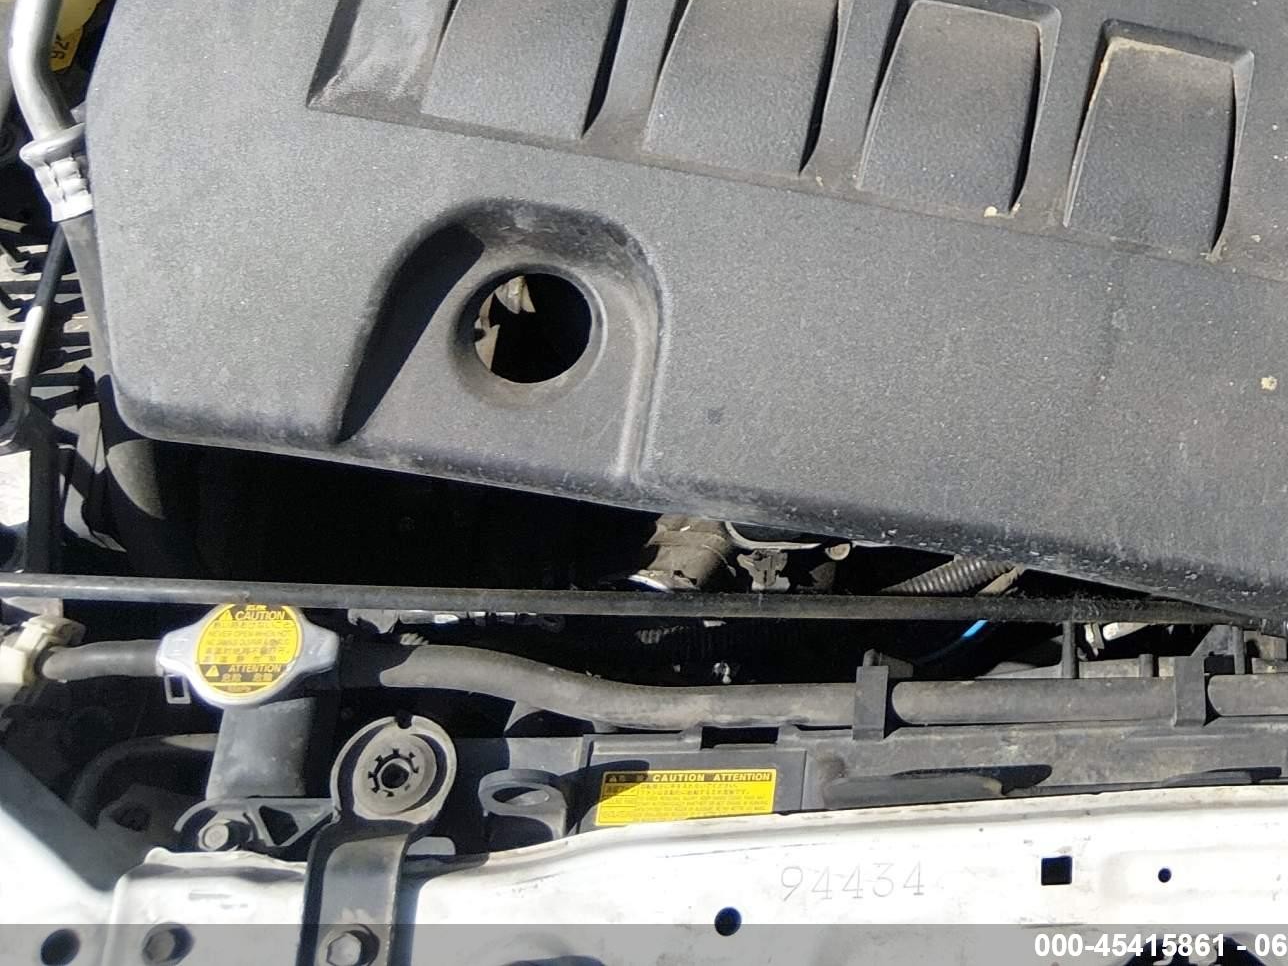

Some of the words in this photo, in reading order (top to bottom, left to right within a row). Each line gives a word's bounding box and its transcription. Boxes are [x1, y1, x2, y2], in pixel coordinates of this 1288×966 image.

[234, 610, 286, 621] CAUTION
[228, 665, 281, 673] ATTENTION
[652, 773, 705, 782] CAUTION
[713, 773, 771, 782] ATTENTION
[781, 861, 925, 902] 94434
